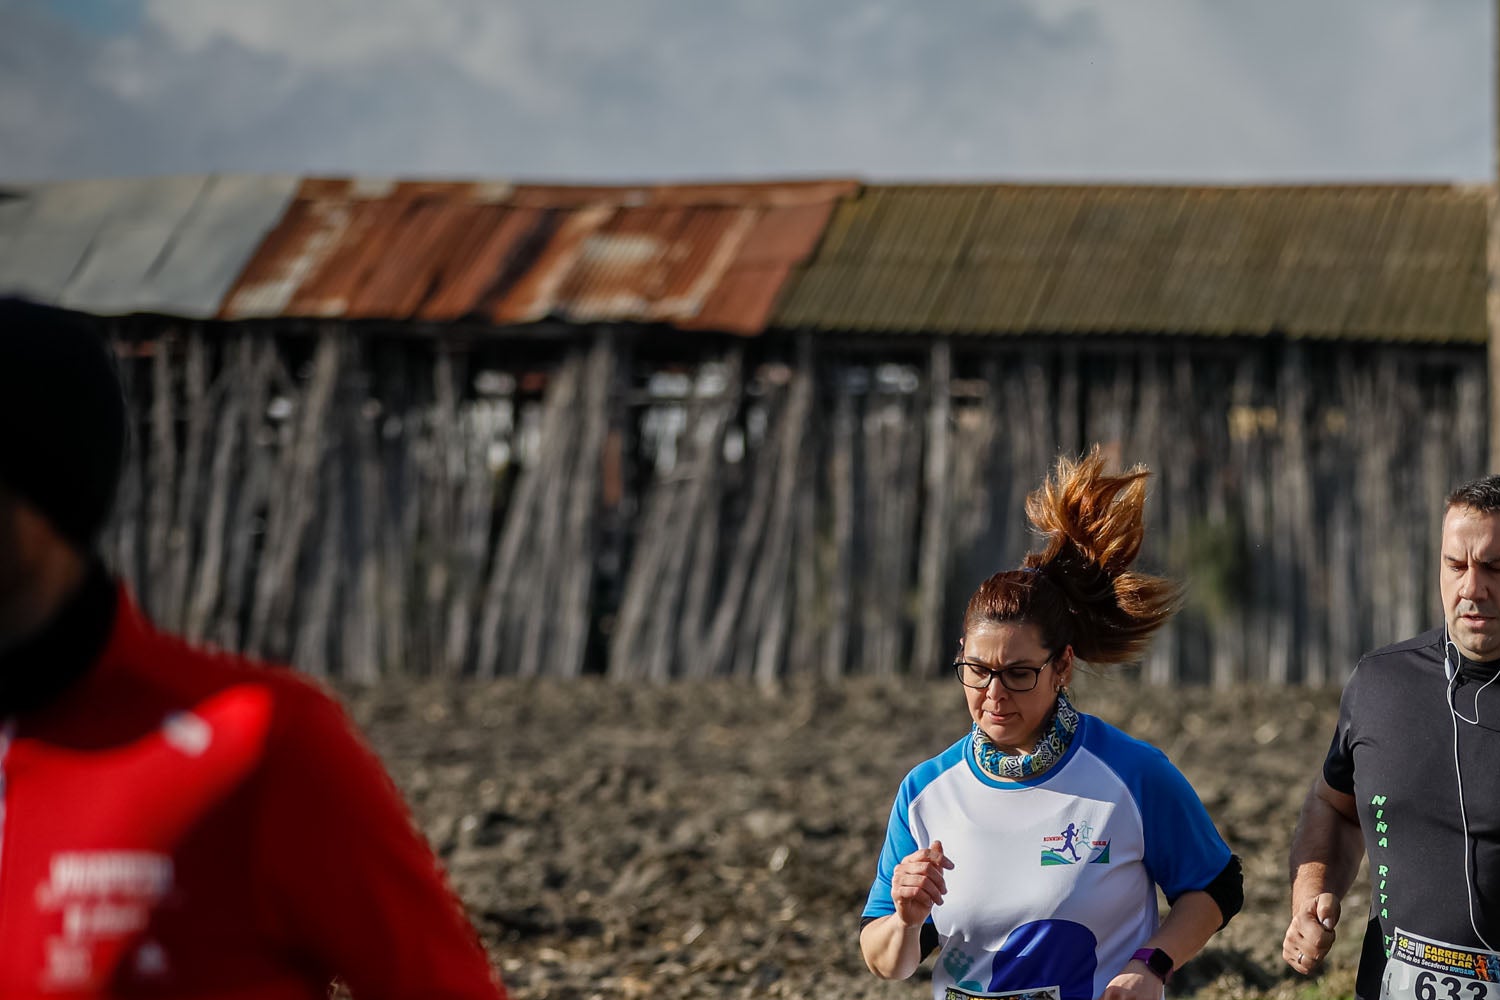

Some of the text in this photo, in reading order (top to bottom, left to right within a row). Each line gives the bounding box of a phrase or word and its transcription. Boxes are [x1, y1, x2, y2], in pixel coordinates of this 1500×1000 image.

[1378, 865, 1389, 919] RITA
[1424, 953, 1473, 969] POPULAR
[1425, 945, 1473, 962] CARRERA
